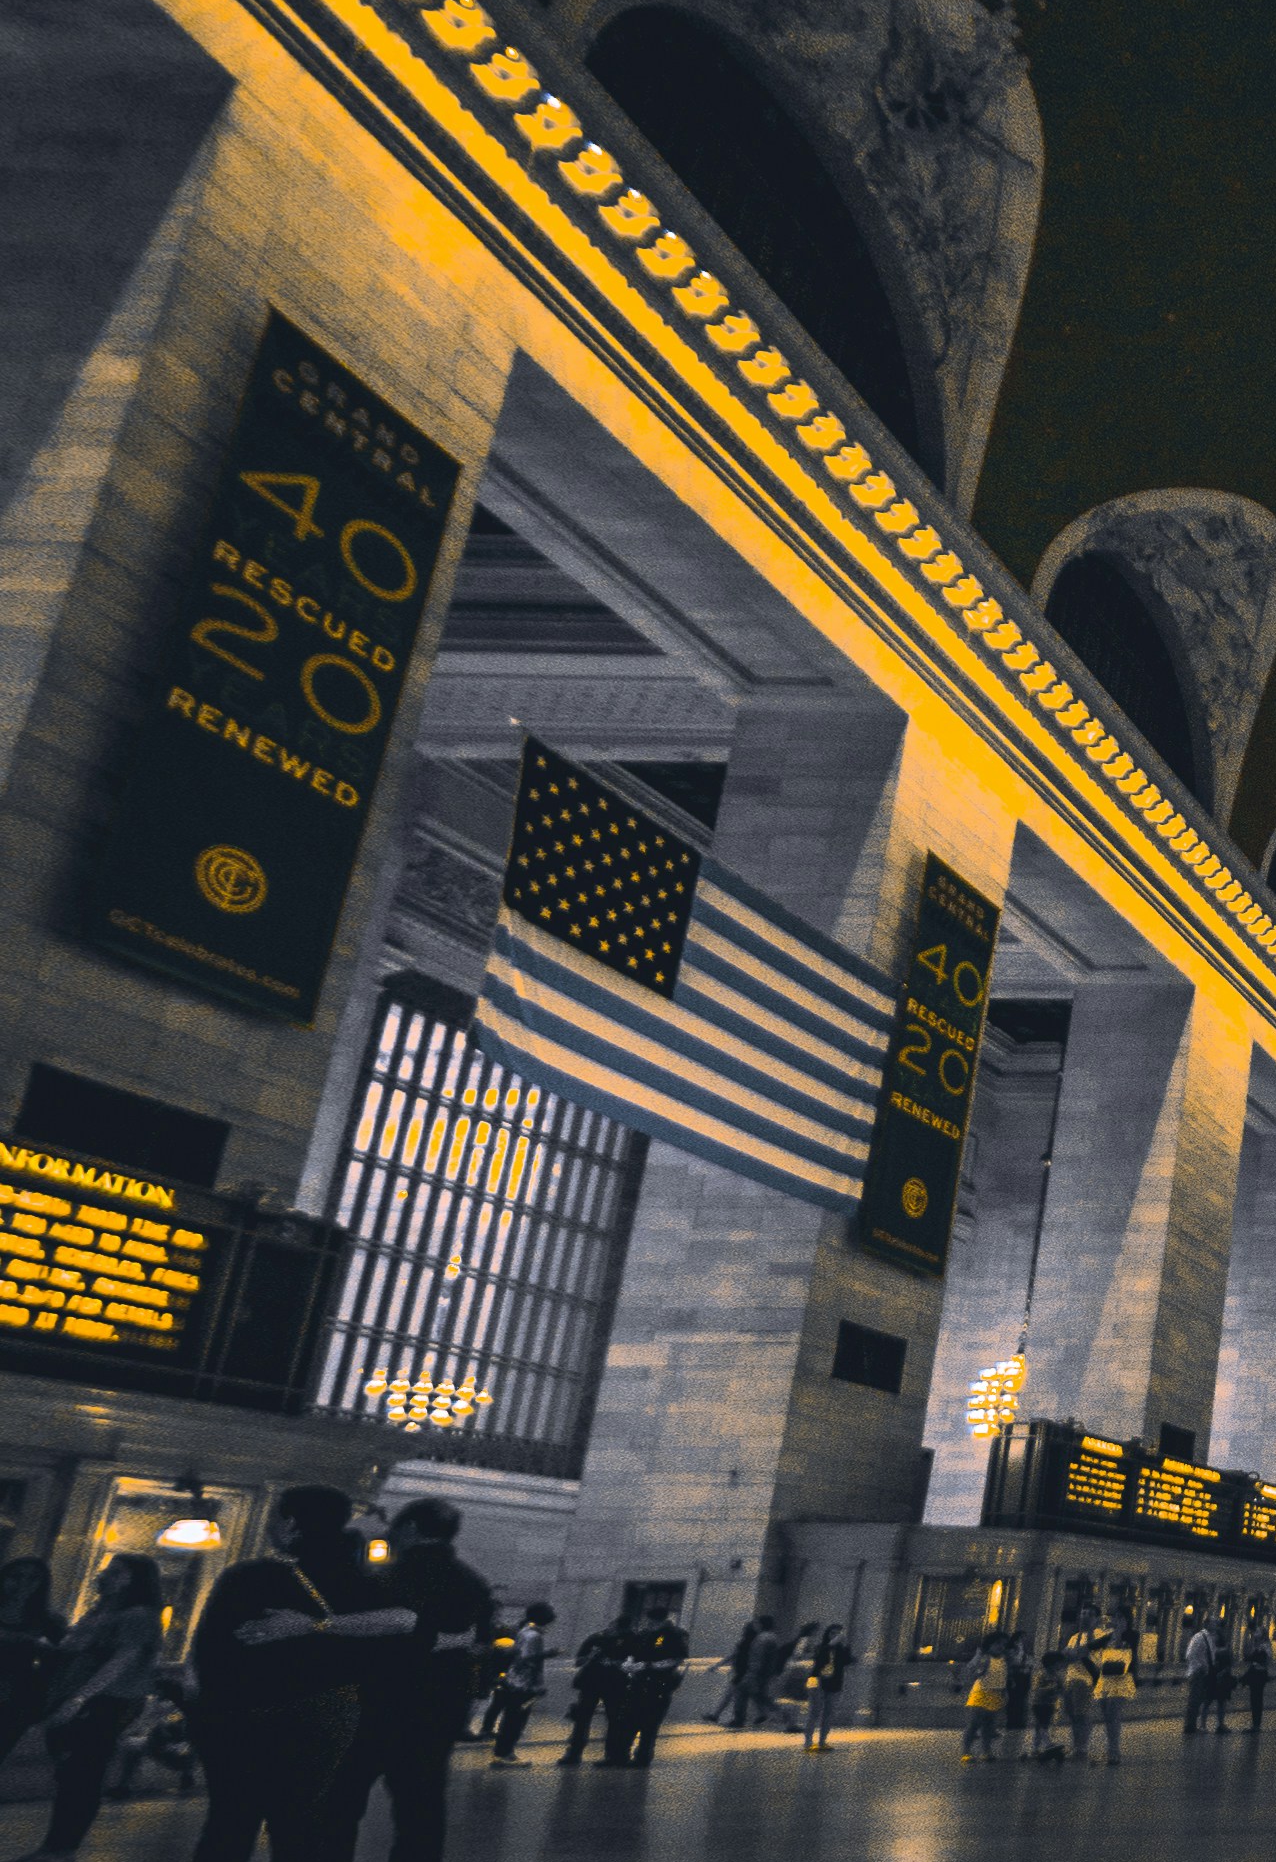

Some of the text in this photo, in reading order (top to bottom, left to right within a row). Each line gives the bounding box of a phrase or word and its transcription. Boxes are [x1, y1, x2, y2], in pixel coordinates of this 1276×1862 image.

[271, 368, 436, 507] CENTRAL
[299, 361, 420, 466] GRAND
[240, 470, 419, 602] 40
[189, 582, 383, 736] 20
[211, 538, 397, 673] RESCUED
[165, 684, 362, 809] RENEWED
[905, 996, 976, 1052] RESCUED
[917, 943, 984, 1007] 40
[890, 1090, 961, 1140] RENEWED
[898, 1023, 969, 1097] 20
